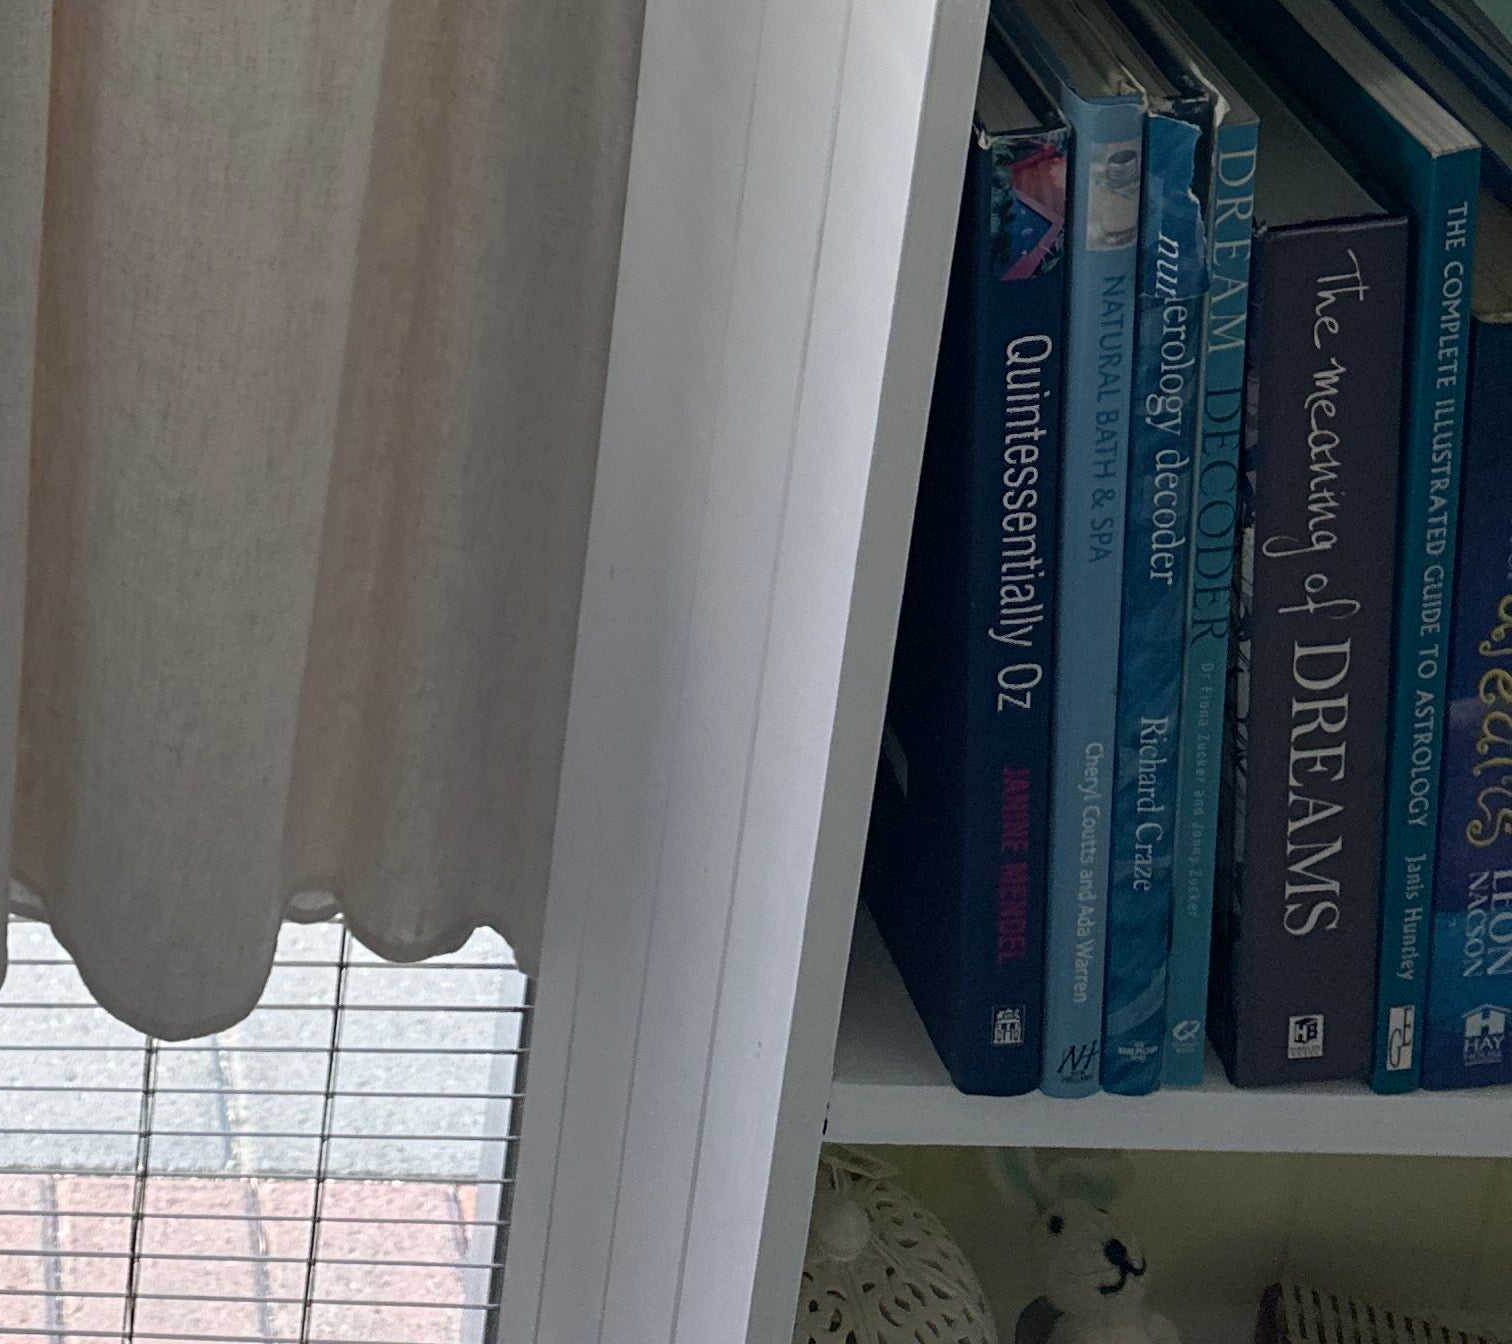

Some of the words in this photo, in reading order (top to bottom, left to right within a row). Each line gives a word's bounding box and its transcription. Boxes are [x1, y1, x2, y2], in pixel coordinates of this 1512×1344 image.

[1206, 148, 1257, 353] DREAM
[1445, 200, 1469, 253] THE
[1313, 248, 1370, 350] The
[1436, 259, 1465, 391] COMPLETE
[1096, 273, 1126, 404] NATURAL
[1093, 410, 1121, 479] BATH
[1424, 398, 1457, 558] ILLUSTRATED
[987, 333, 1053, 647] Quintessentially
[1091, 487, 1116, 510] &
[1148, 448, 1190, 587] decoder
[1190, 387, 1242, 647] DECODER
[1088, 517, 1115, 563] SPA
[1277, 572, 1361, 620] of
[1419, 564, 1445, 637] GUIDE
[996, 662, 1044, 712] Oz
[1416, 642, 1439, 681] TO
[1078, 741, 1104, 801] Cheryl
[1136, 715, 1170, 813] Richard
[1282, 637, 1351, 937] DREAMS
[1407, 688, 1436, 829] ASTROLOGY
[1077, 868, 1097, 903] and
[1132, 821, 1164, 893] Craze
[1404, 853, 1427, 901] Janis
[1395, 907, 1424, 982] Huntley
[1462, 870, 1490, 978] NACSON
[1073, 938, 1094, 1004] Warren
